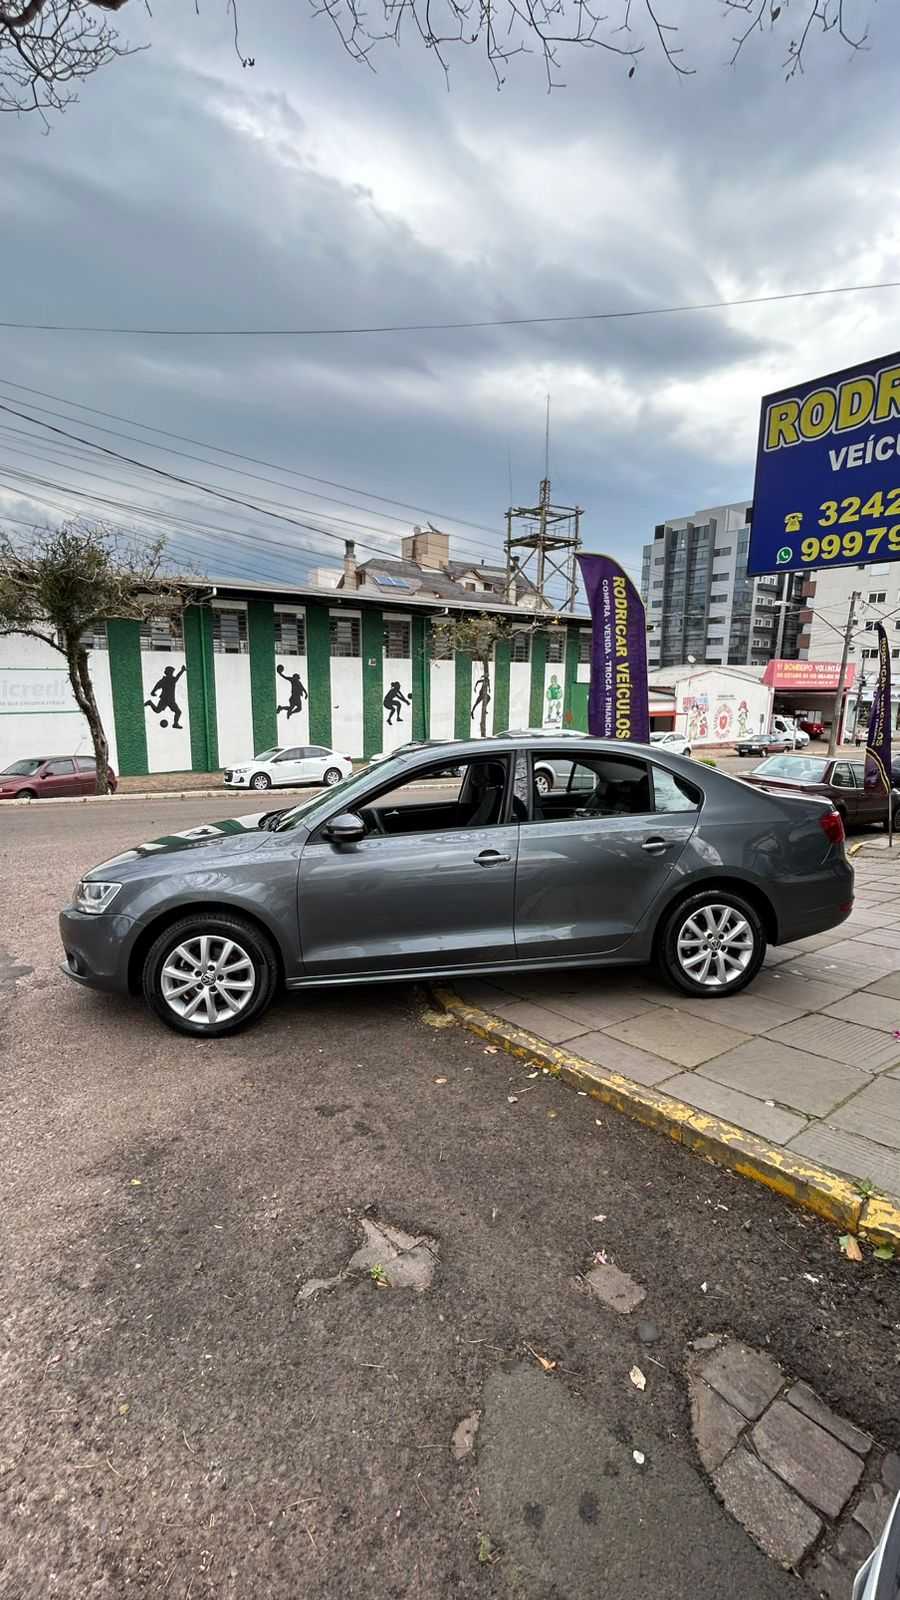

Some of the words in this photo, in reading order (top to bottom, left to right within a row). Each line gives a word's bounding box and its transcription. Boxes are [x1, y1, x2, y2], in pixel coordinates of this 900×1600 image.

[764, 364, 900, 452] RODR
[829, 434, 900, 471] VEÍC
[818, 487, 900, 527] 3242
[800, 524, 900, 562] 99979
[602, 579, 611, 617] COMPRA
[613, 576, 628, 657] RODRICAR
[604, 623, 612, 655] VENDA
[0, 680, 65, 696] icredi
[604, 660, 612, 691] TROCA
[604, 697, 612, 737] FINANCIA
[616, 662, 633, 738] VEÍCULOS
